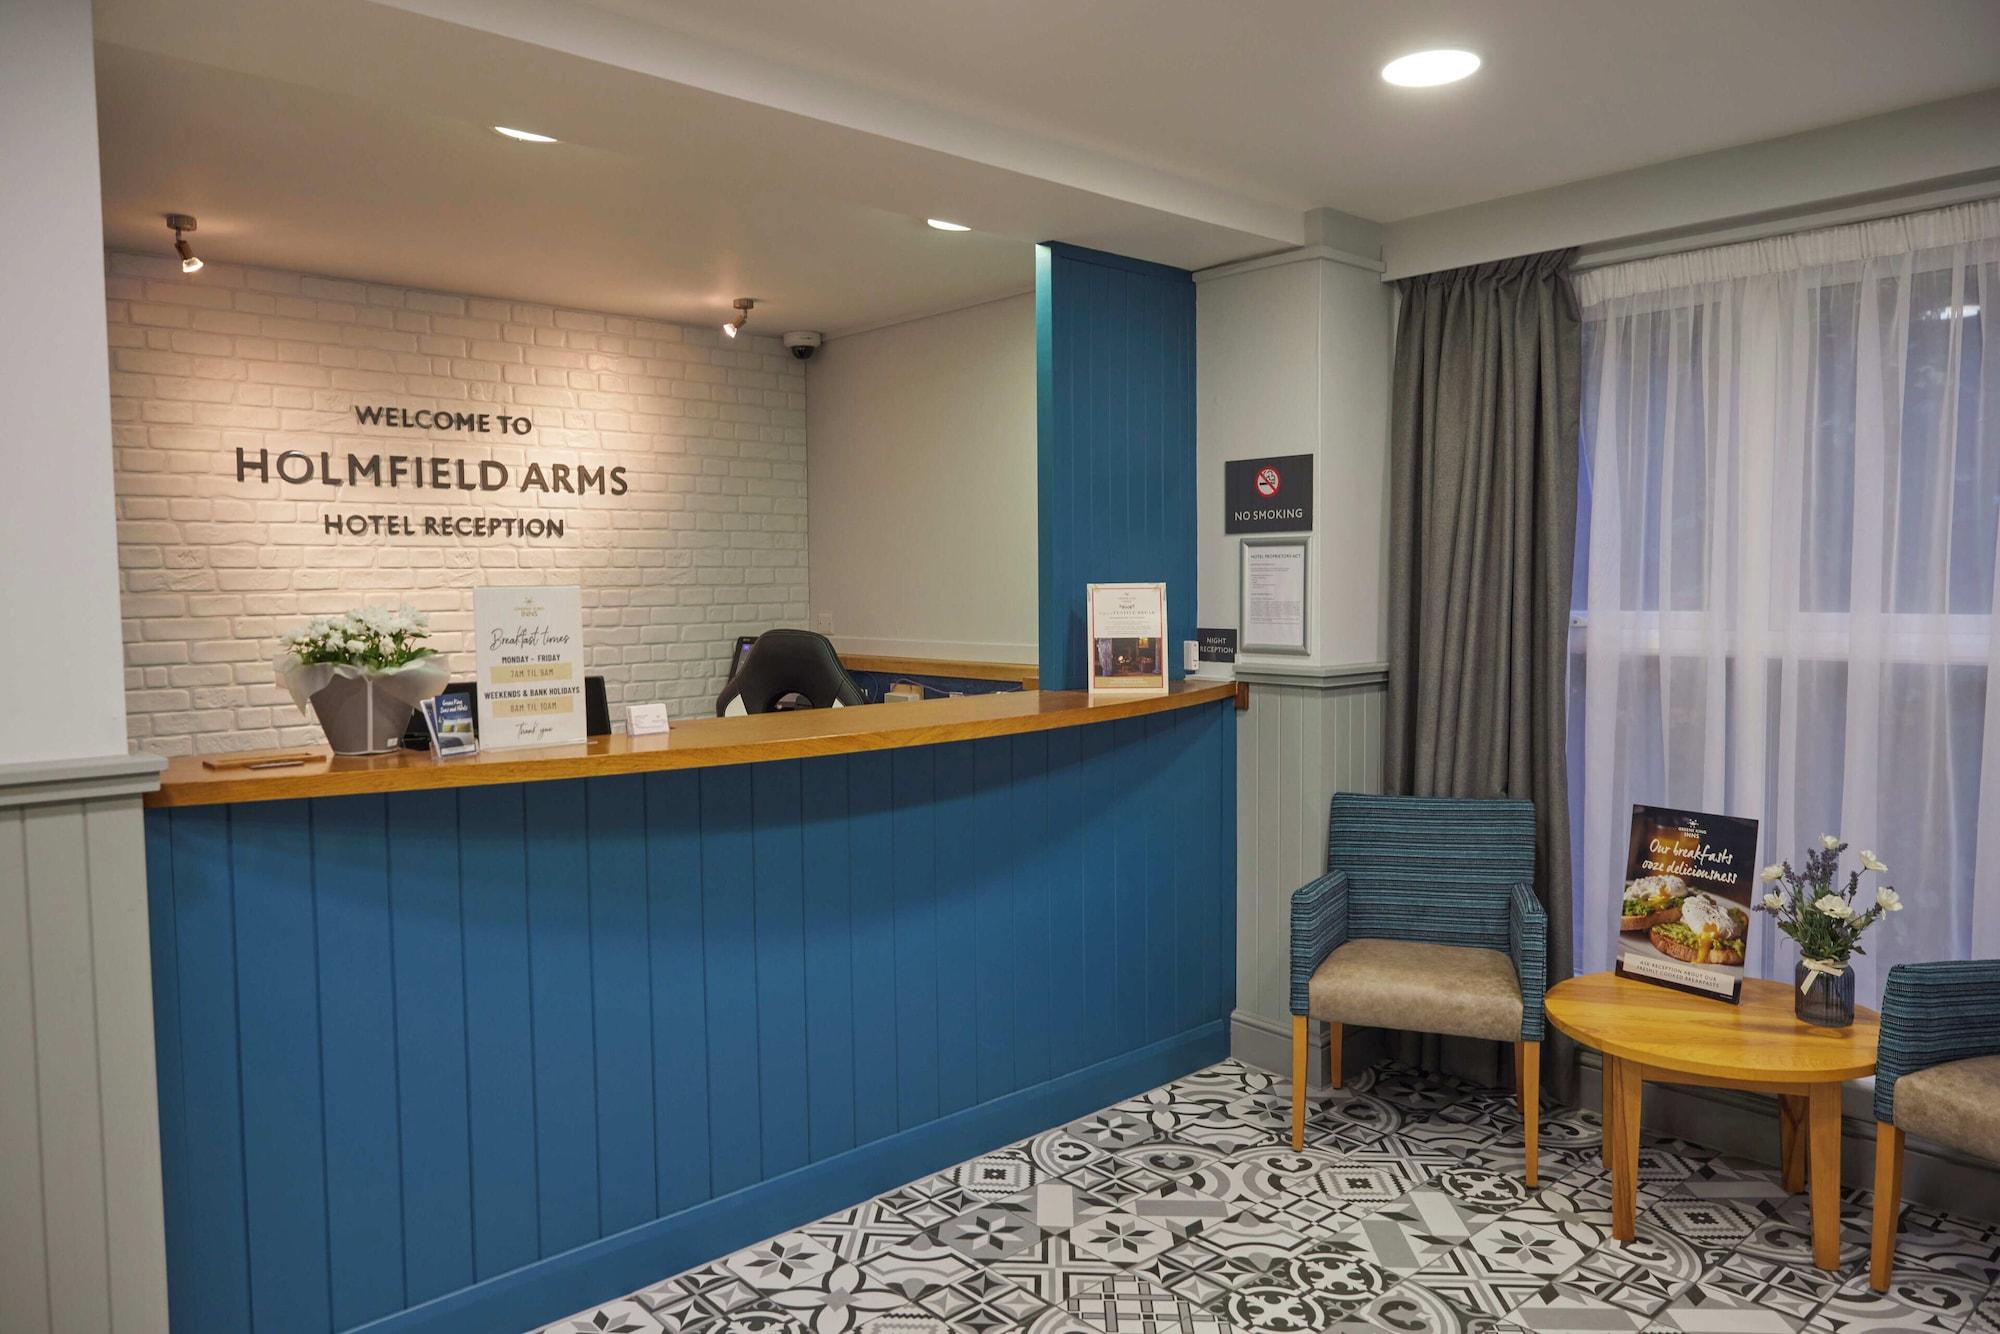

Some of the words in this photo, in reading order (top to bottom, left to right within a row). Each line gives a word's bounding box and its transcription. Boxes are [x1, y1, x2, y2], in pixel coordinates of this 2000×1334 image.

[355, 406, 490, 433] WELCOME
[497, 414, 532, 435] TO
[235, 447, 509, 491] HOLMFIELD
[520, 462, 628, 496] ARMS
[324, 514, 415, 537] HOTEL
[424, 516, 565, 539] RECEPTION
[1234, 510, 1250, 521] NO
[1253, 508, 1303, 521] SMOKING
[490, 625, 540, 651] Breakfast
[541, 625, 570, 646] times
[1199, 646, 1234, 654] RECEPTION
[502, 655, 529, 664] MONDAY
[537, 654, 561, 662] FRIDAY
[511, 670, 524, 678] 7AM
[527, 669, 538, 677] TIL
[484, 690, 521, 700] WEEKENDS
[523, 689, 528, 697] &
[530, 688, 547, 697] BANK
[549, 686, 580, 695] HOLIDAYS
[1649, 838, 1671, 855] Our
[1673, 841, 1733, 865] breakfasts
[1641, 859, 1664, 871] ooze
[1666, 860, 1738, 884] deliciousness
